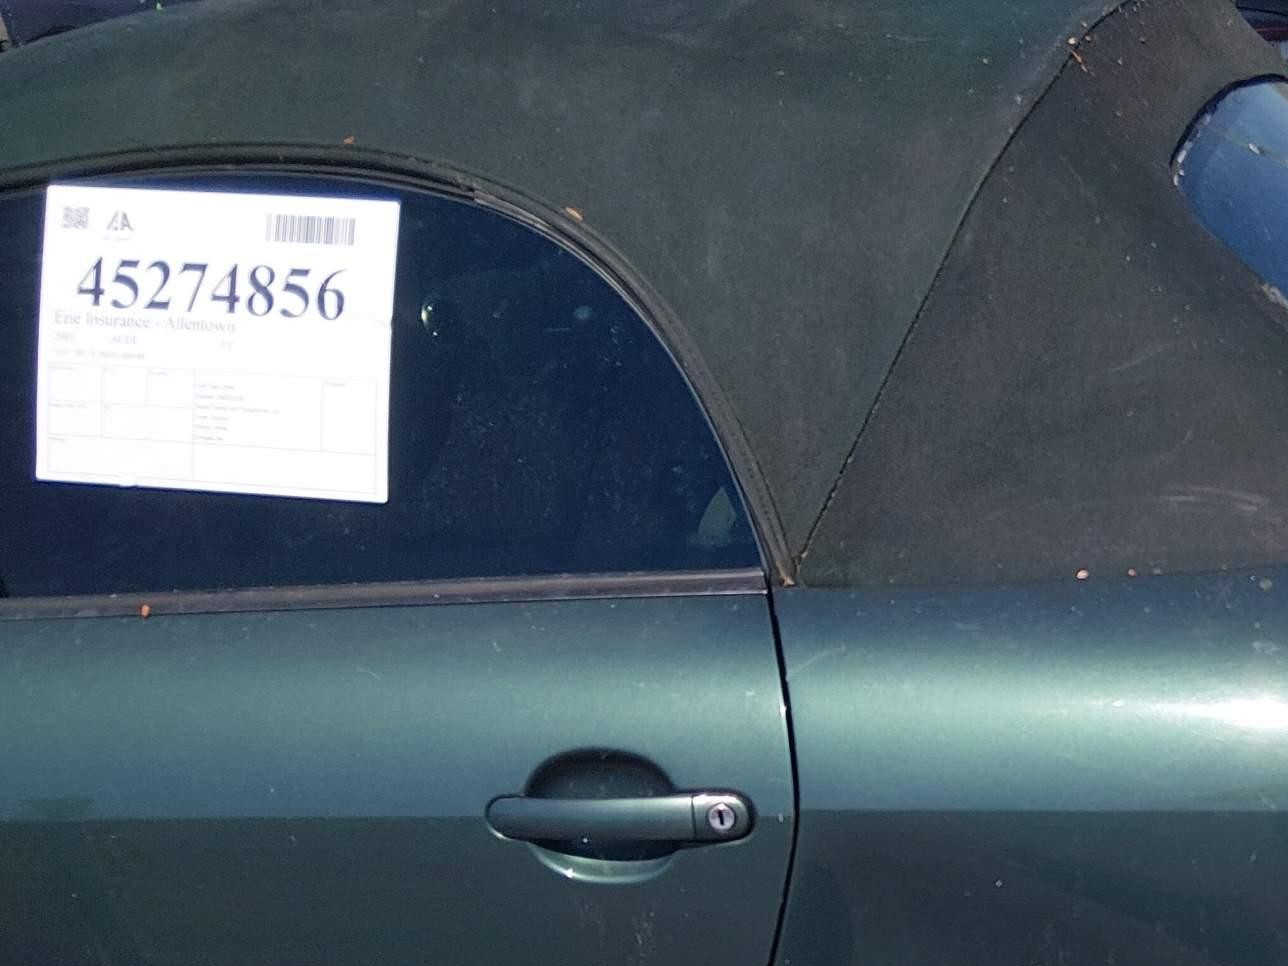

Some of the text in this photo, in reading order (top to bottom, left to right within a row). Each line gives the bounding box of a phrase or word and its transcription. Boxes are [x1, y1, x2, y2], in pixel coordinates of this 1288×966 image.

[77, 256, 347, 320] 45274856
[86, 312, 150, 329] Insurance
[165, 317, 236, 334] Allentown
